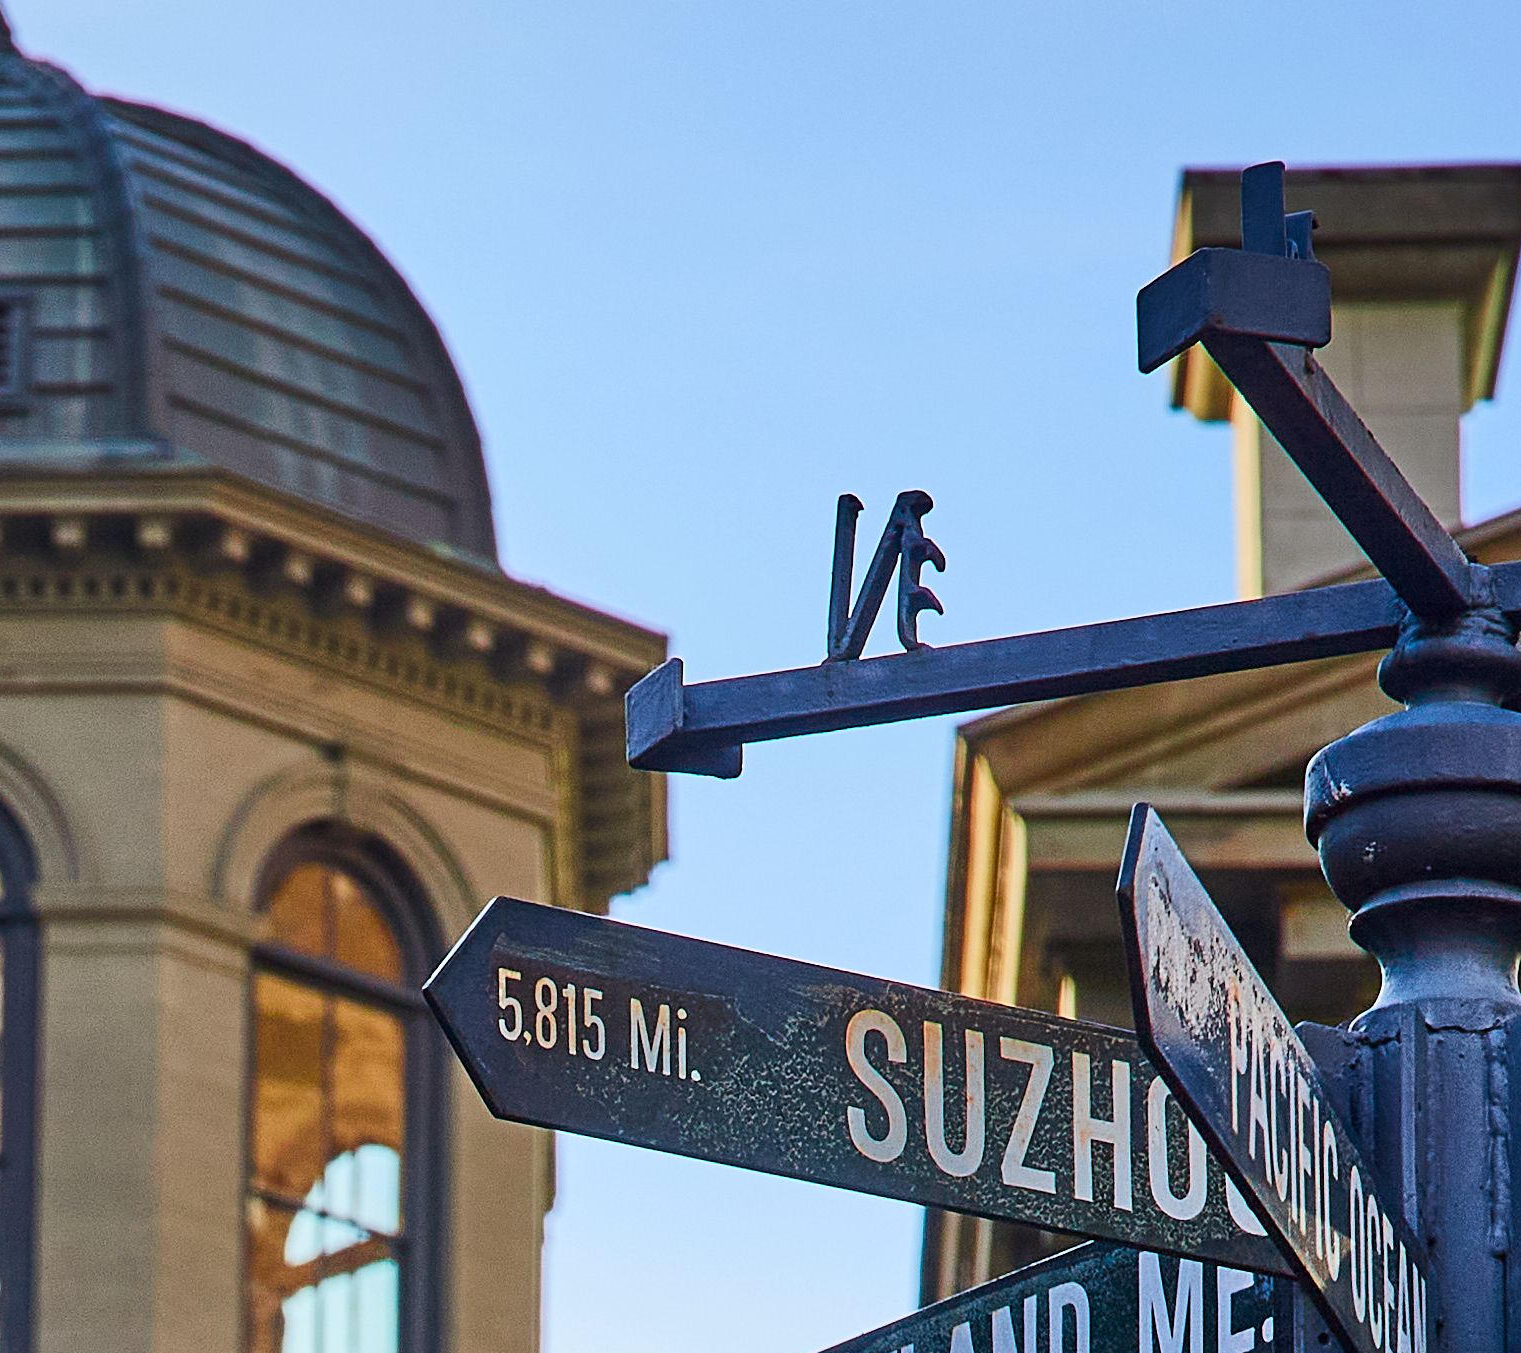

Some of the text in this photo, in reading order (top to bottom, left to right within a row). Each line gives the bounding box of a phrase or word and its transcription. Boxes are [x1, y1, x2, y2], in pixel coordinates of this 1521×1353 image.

[497, 967, 606, 1061] 5,815
[629, 997, 702, 1082] Mi.
[1228, 980, 1341, 1284] PACIFIC
